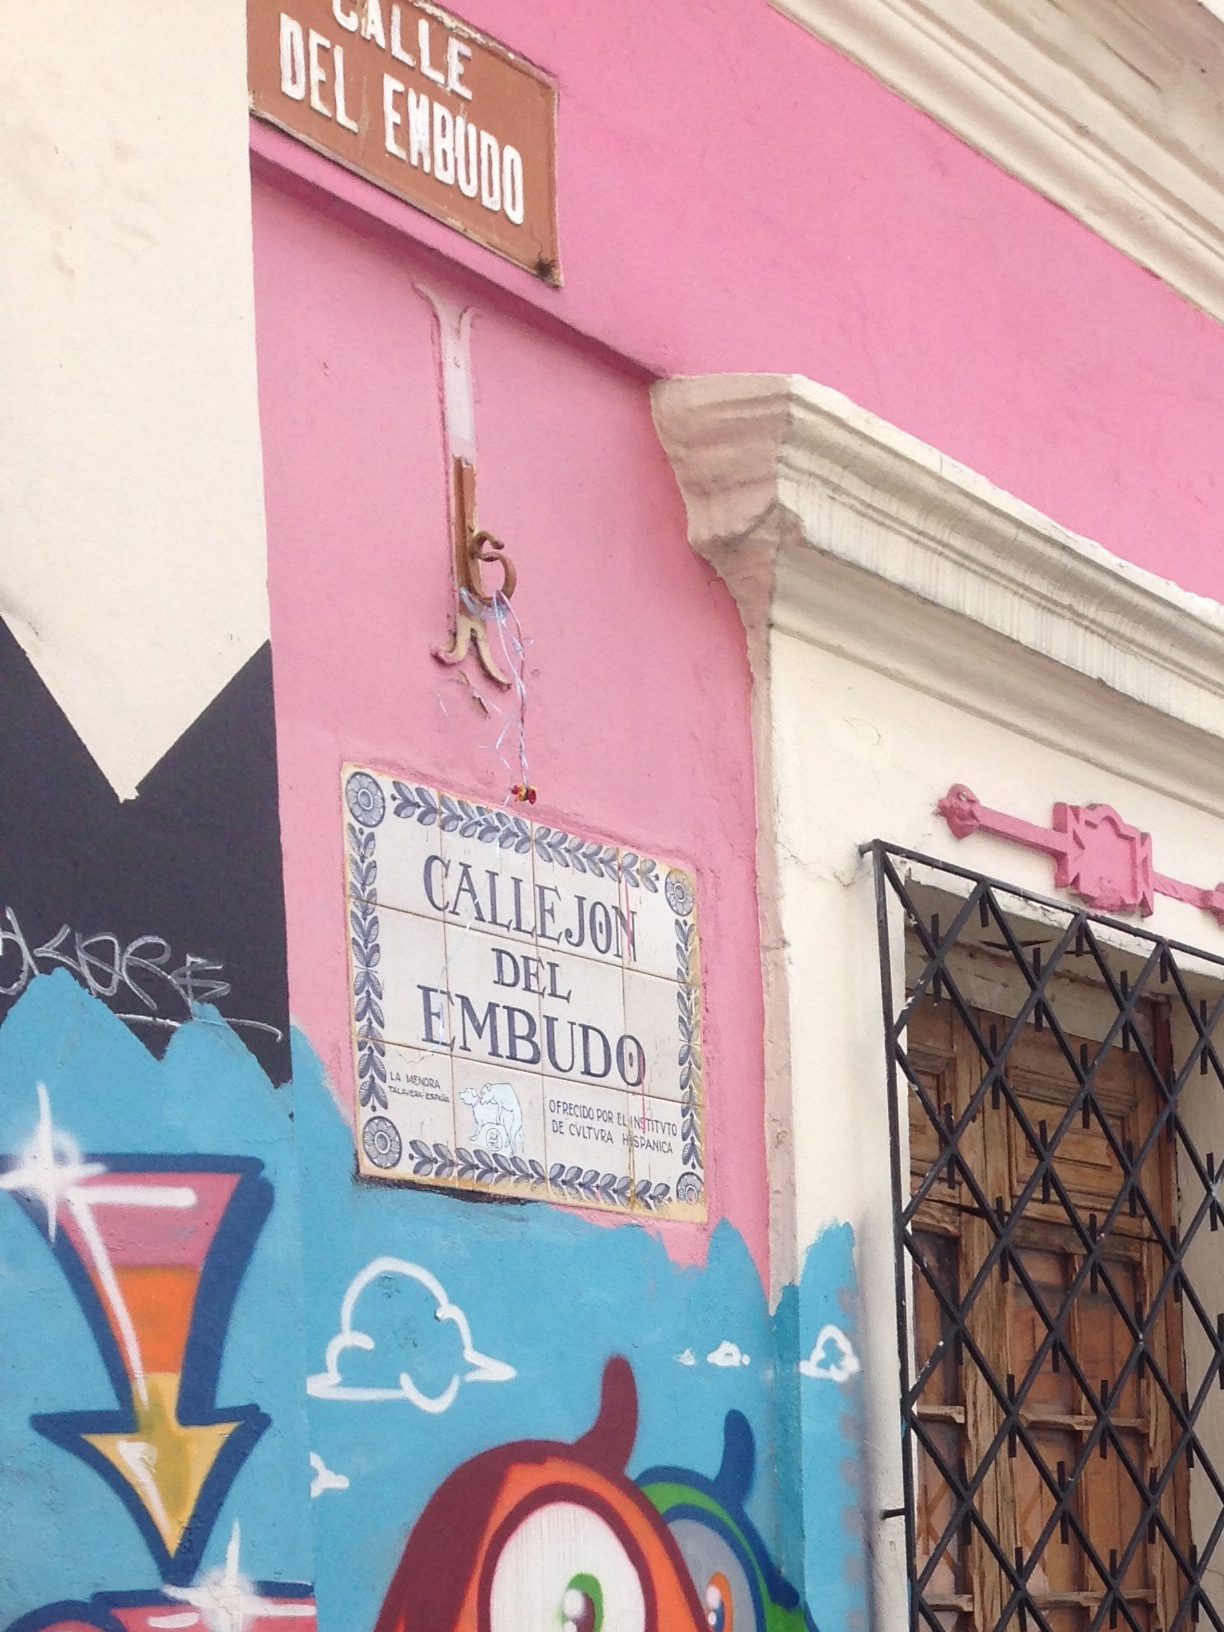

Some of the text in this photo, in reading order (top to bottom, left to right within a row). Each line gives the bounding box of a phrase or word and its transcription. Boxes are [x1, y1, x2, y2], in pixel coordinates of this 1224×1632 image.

[279, 12, 525, 226] DEL EMBUDO
[422, 854, 637, 963] CALLEJON
[490, 947, 572, 1002] DEL
[416, 983, 647, 1088] EMBUDO
[389, 1071, 402, 1083] LA
[548, 1098, 595, 1121] OFRECIDO
[596, 1107, 614, 1124] POR
[616, 1111, 628, 1128] EL
[551, 1119, 674, 1154] DE CVLTVRA HISPANICA
